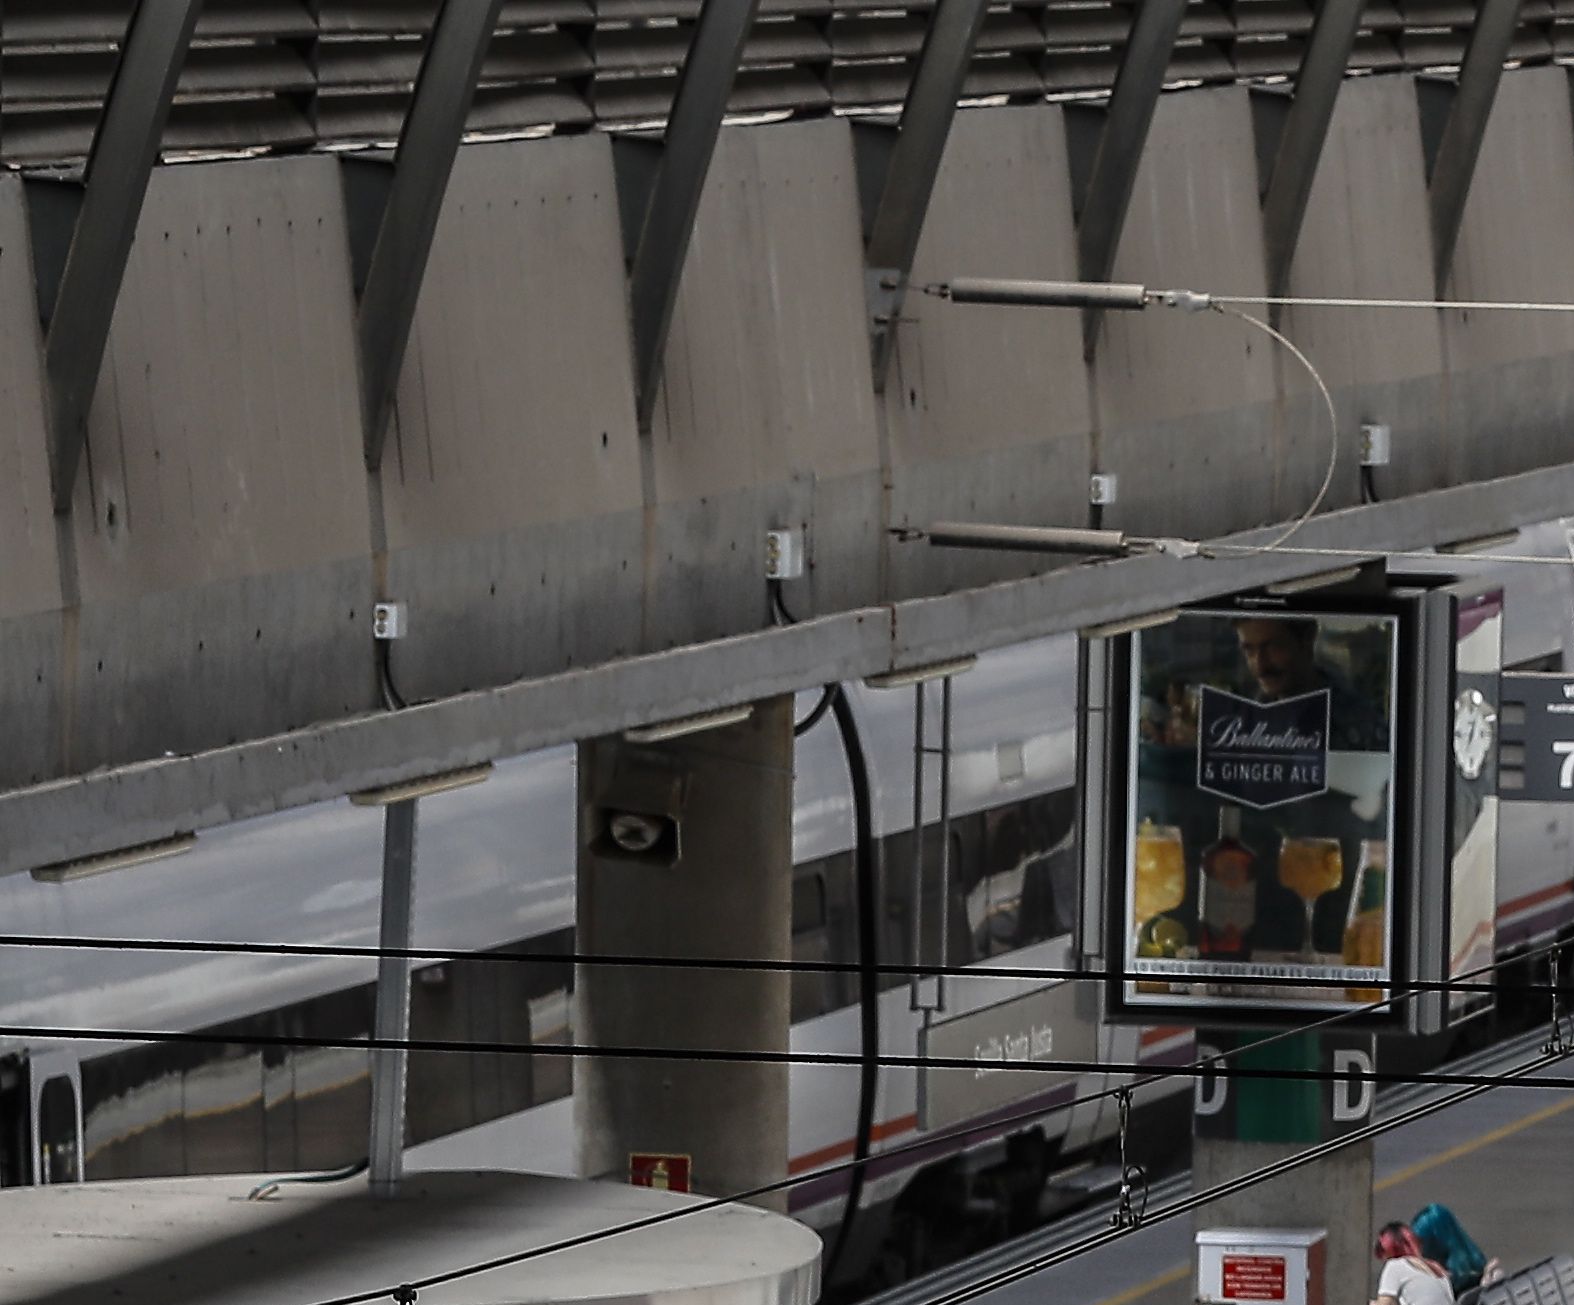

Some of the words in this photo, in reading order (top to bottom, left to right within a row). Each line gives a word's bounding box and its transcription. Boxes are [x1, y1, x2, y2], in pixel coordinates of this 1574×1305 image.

[1222, 763, 1283, 782] GINGER
[1290, 765, 1322, 783] ALE
[1193, 1044, 1228, 1116] D
[1333, 1049, 1376, 1121] D
